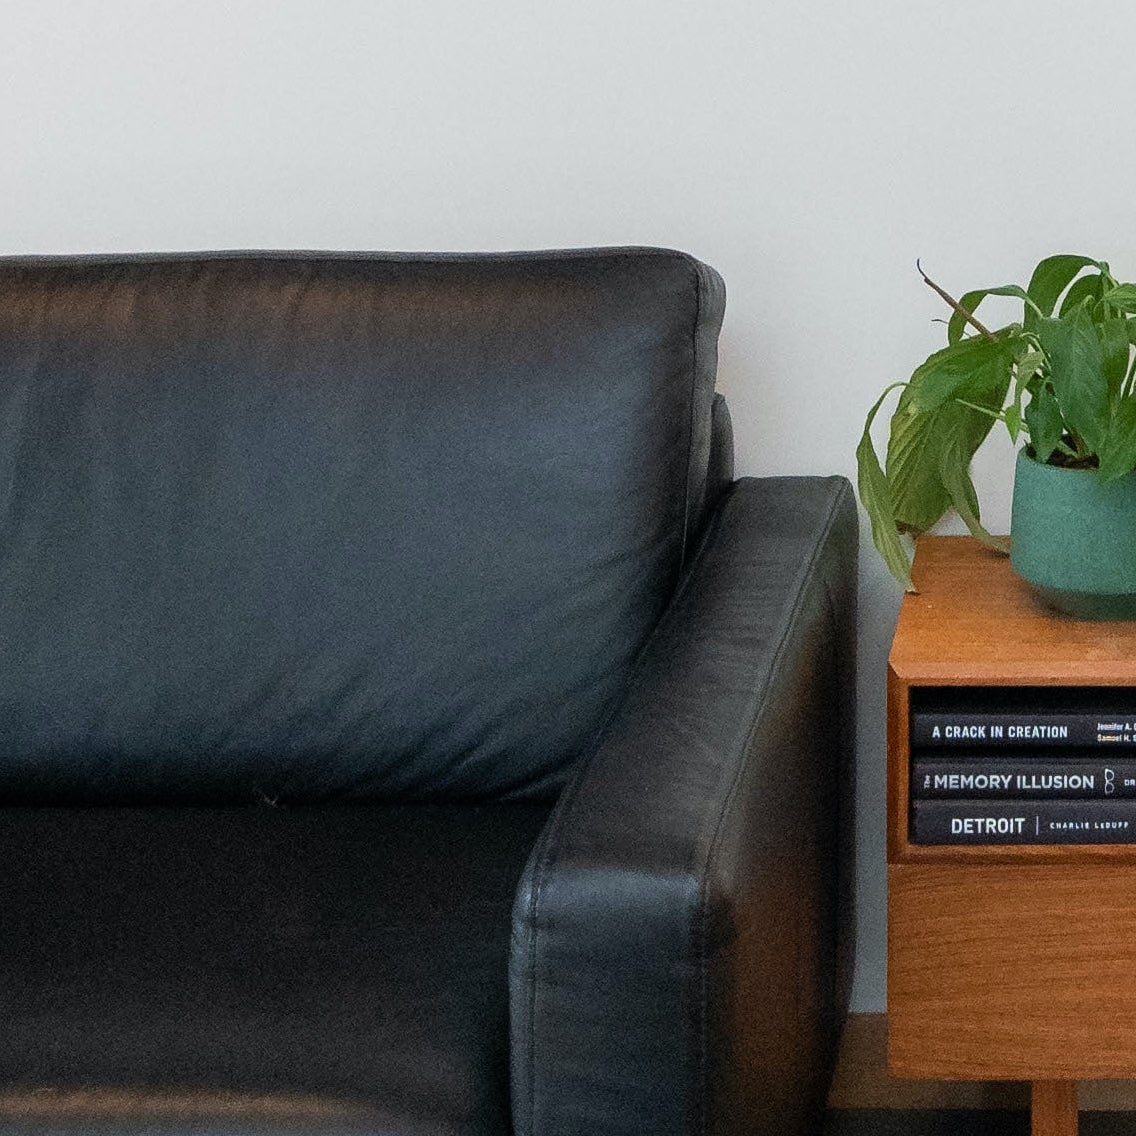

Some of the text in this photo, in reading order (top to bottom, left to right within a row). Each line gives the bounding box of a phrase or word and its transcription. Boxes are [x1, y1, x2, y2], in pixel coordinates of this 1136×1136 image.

[932, 725, 1068, 739] A CRACK IN CREATION
[934, 774, 1012, 790] MEMORY
[1016, 774, 1095, 790] ILLUSION
[1124, 778, 1136, 787] DR
[951, 817, 1026, 835] DETROIT
[1049, 821, 1090, 830] CHARLIE
